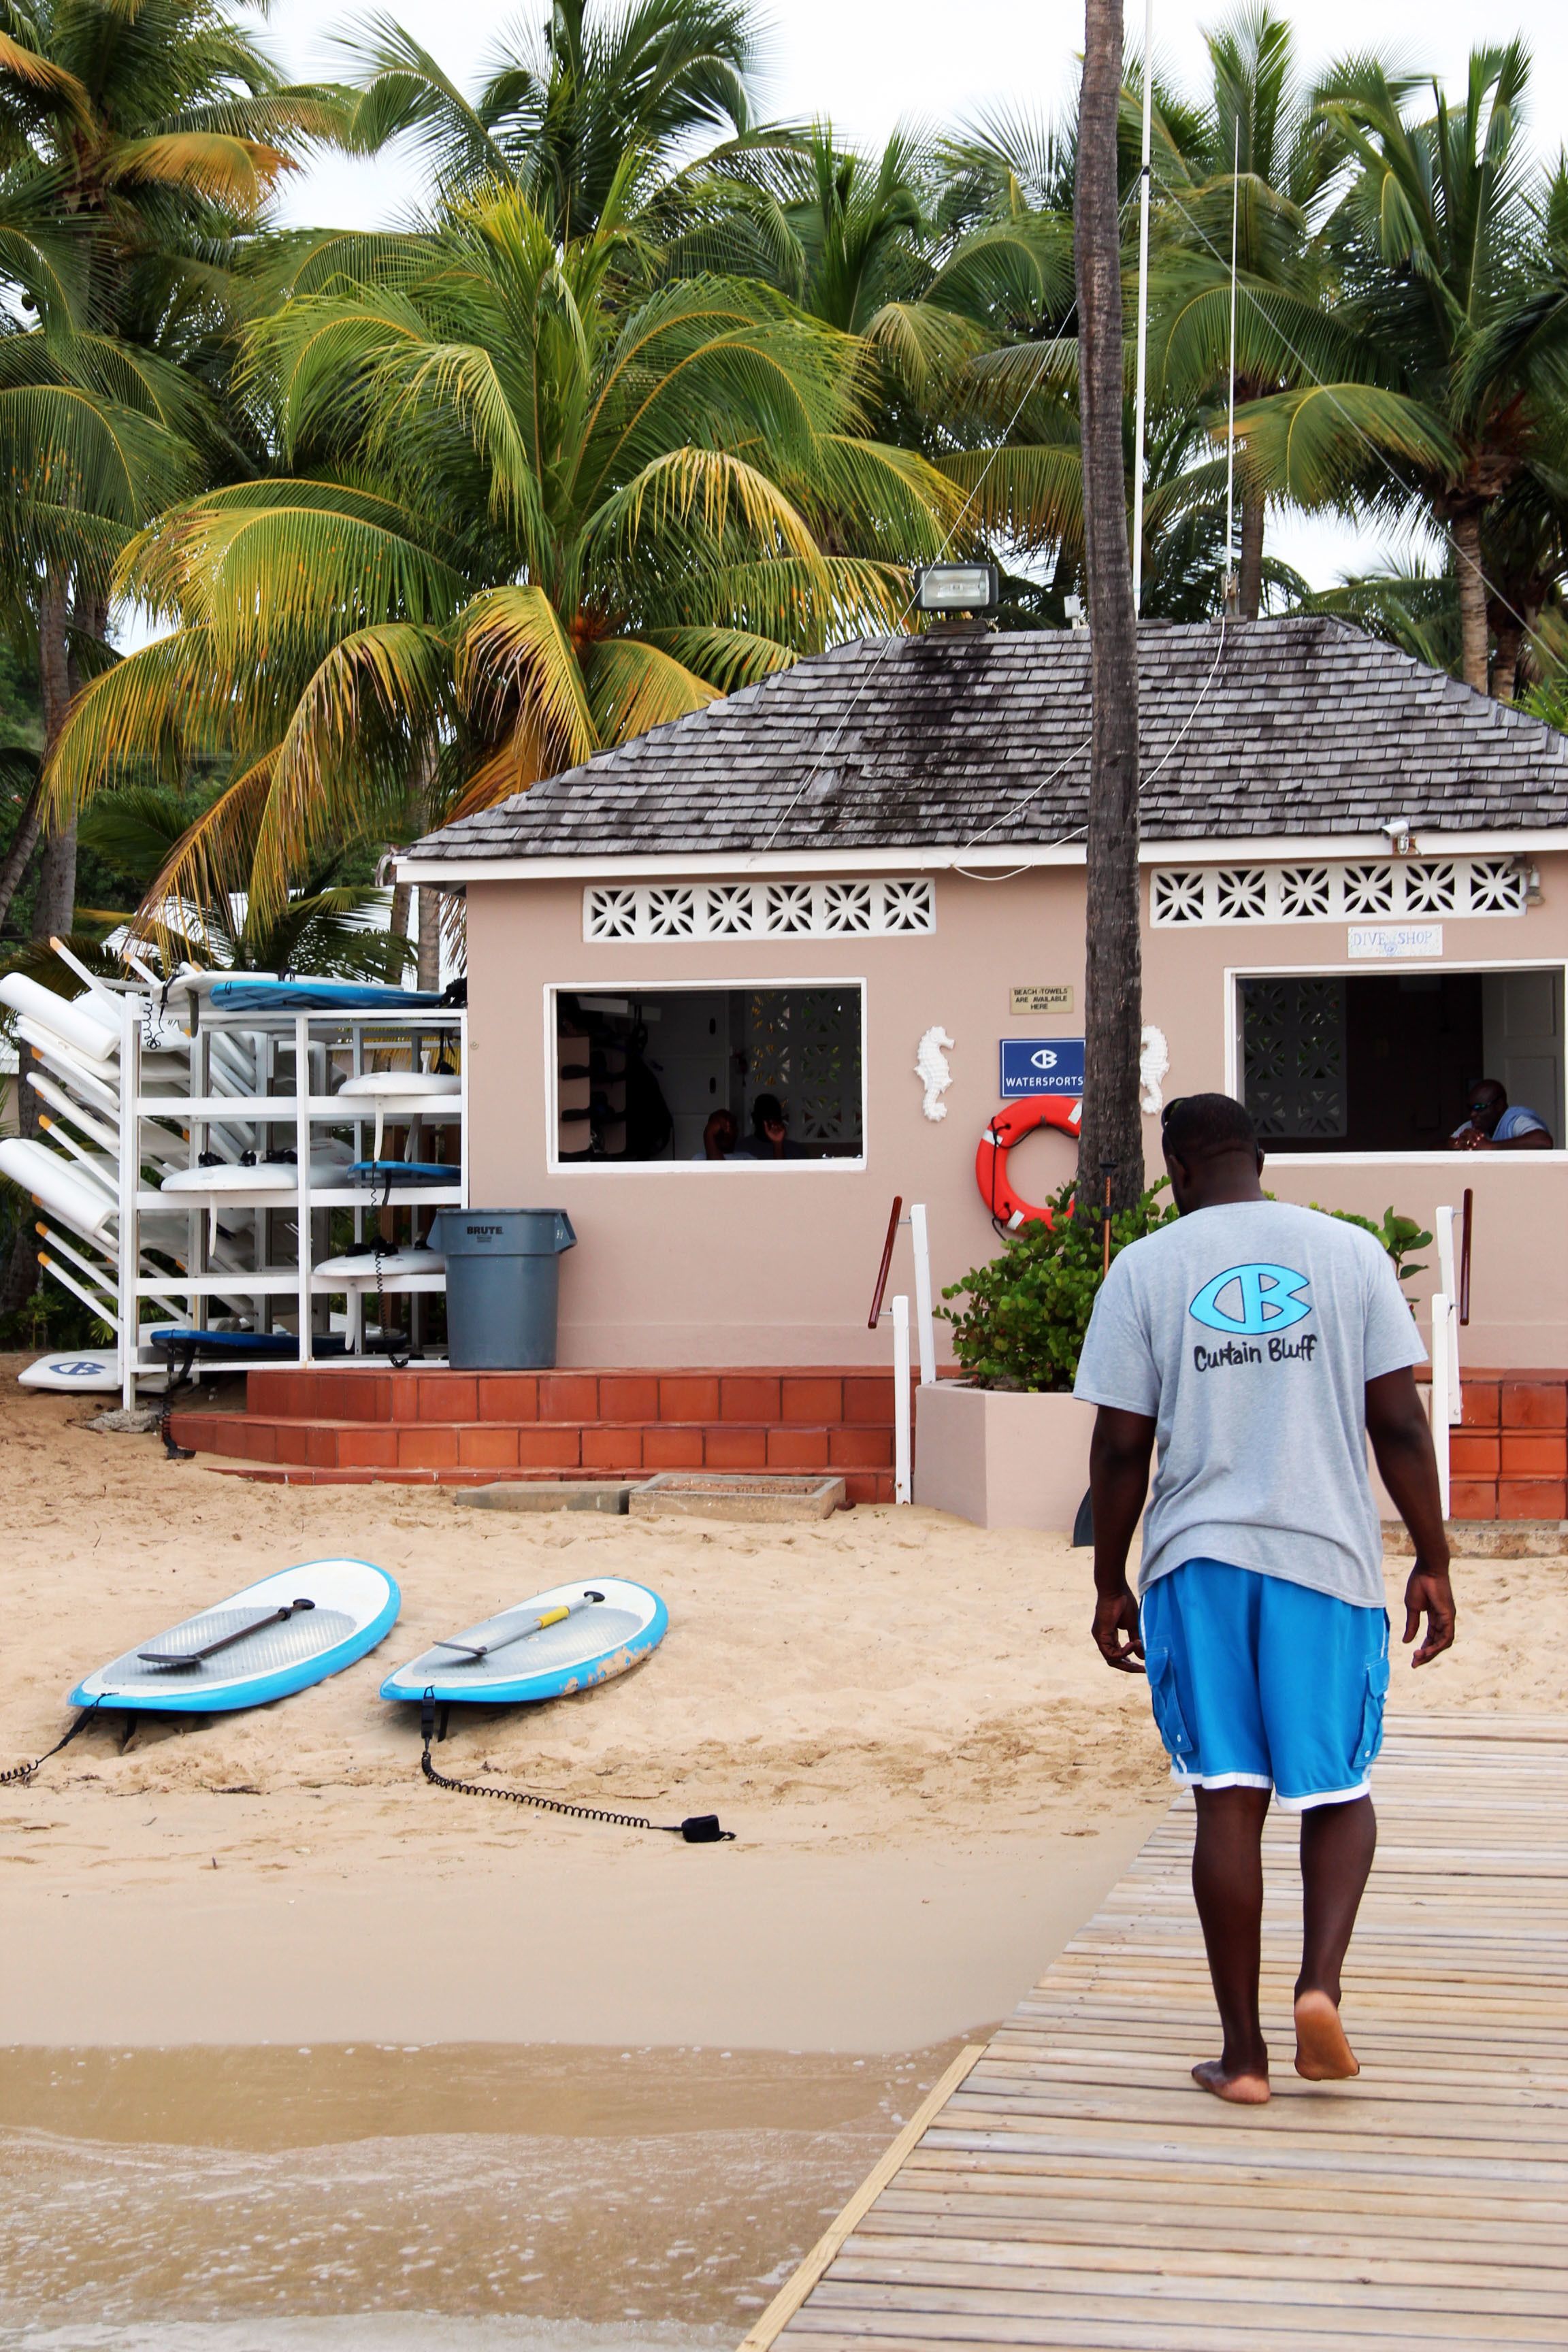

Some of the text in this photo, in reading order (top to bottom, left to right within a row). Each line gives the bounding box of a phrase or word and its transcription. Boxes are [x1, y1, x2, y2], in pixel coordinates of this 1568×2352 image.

[1352, 930, 1433, 945] DIVE SHOP
[1005, 1076, 1083, 1087] WATERSPORTS
[467, 1226, 504, 1235] BRUTE
[1194, 1334, 1318, 1373] Curtain Bluff
